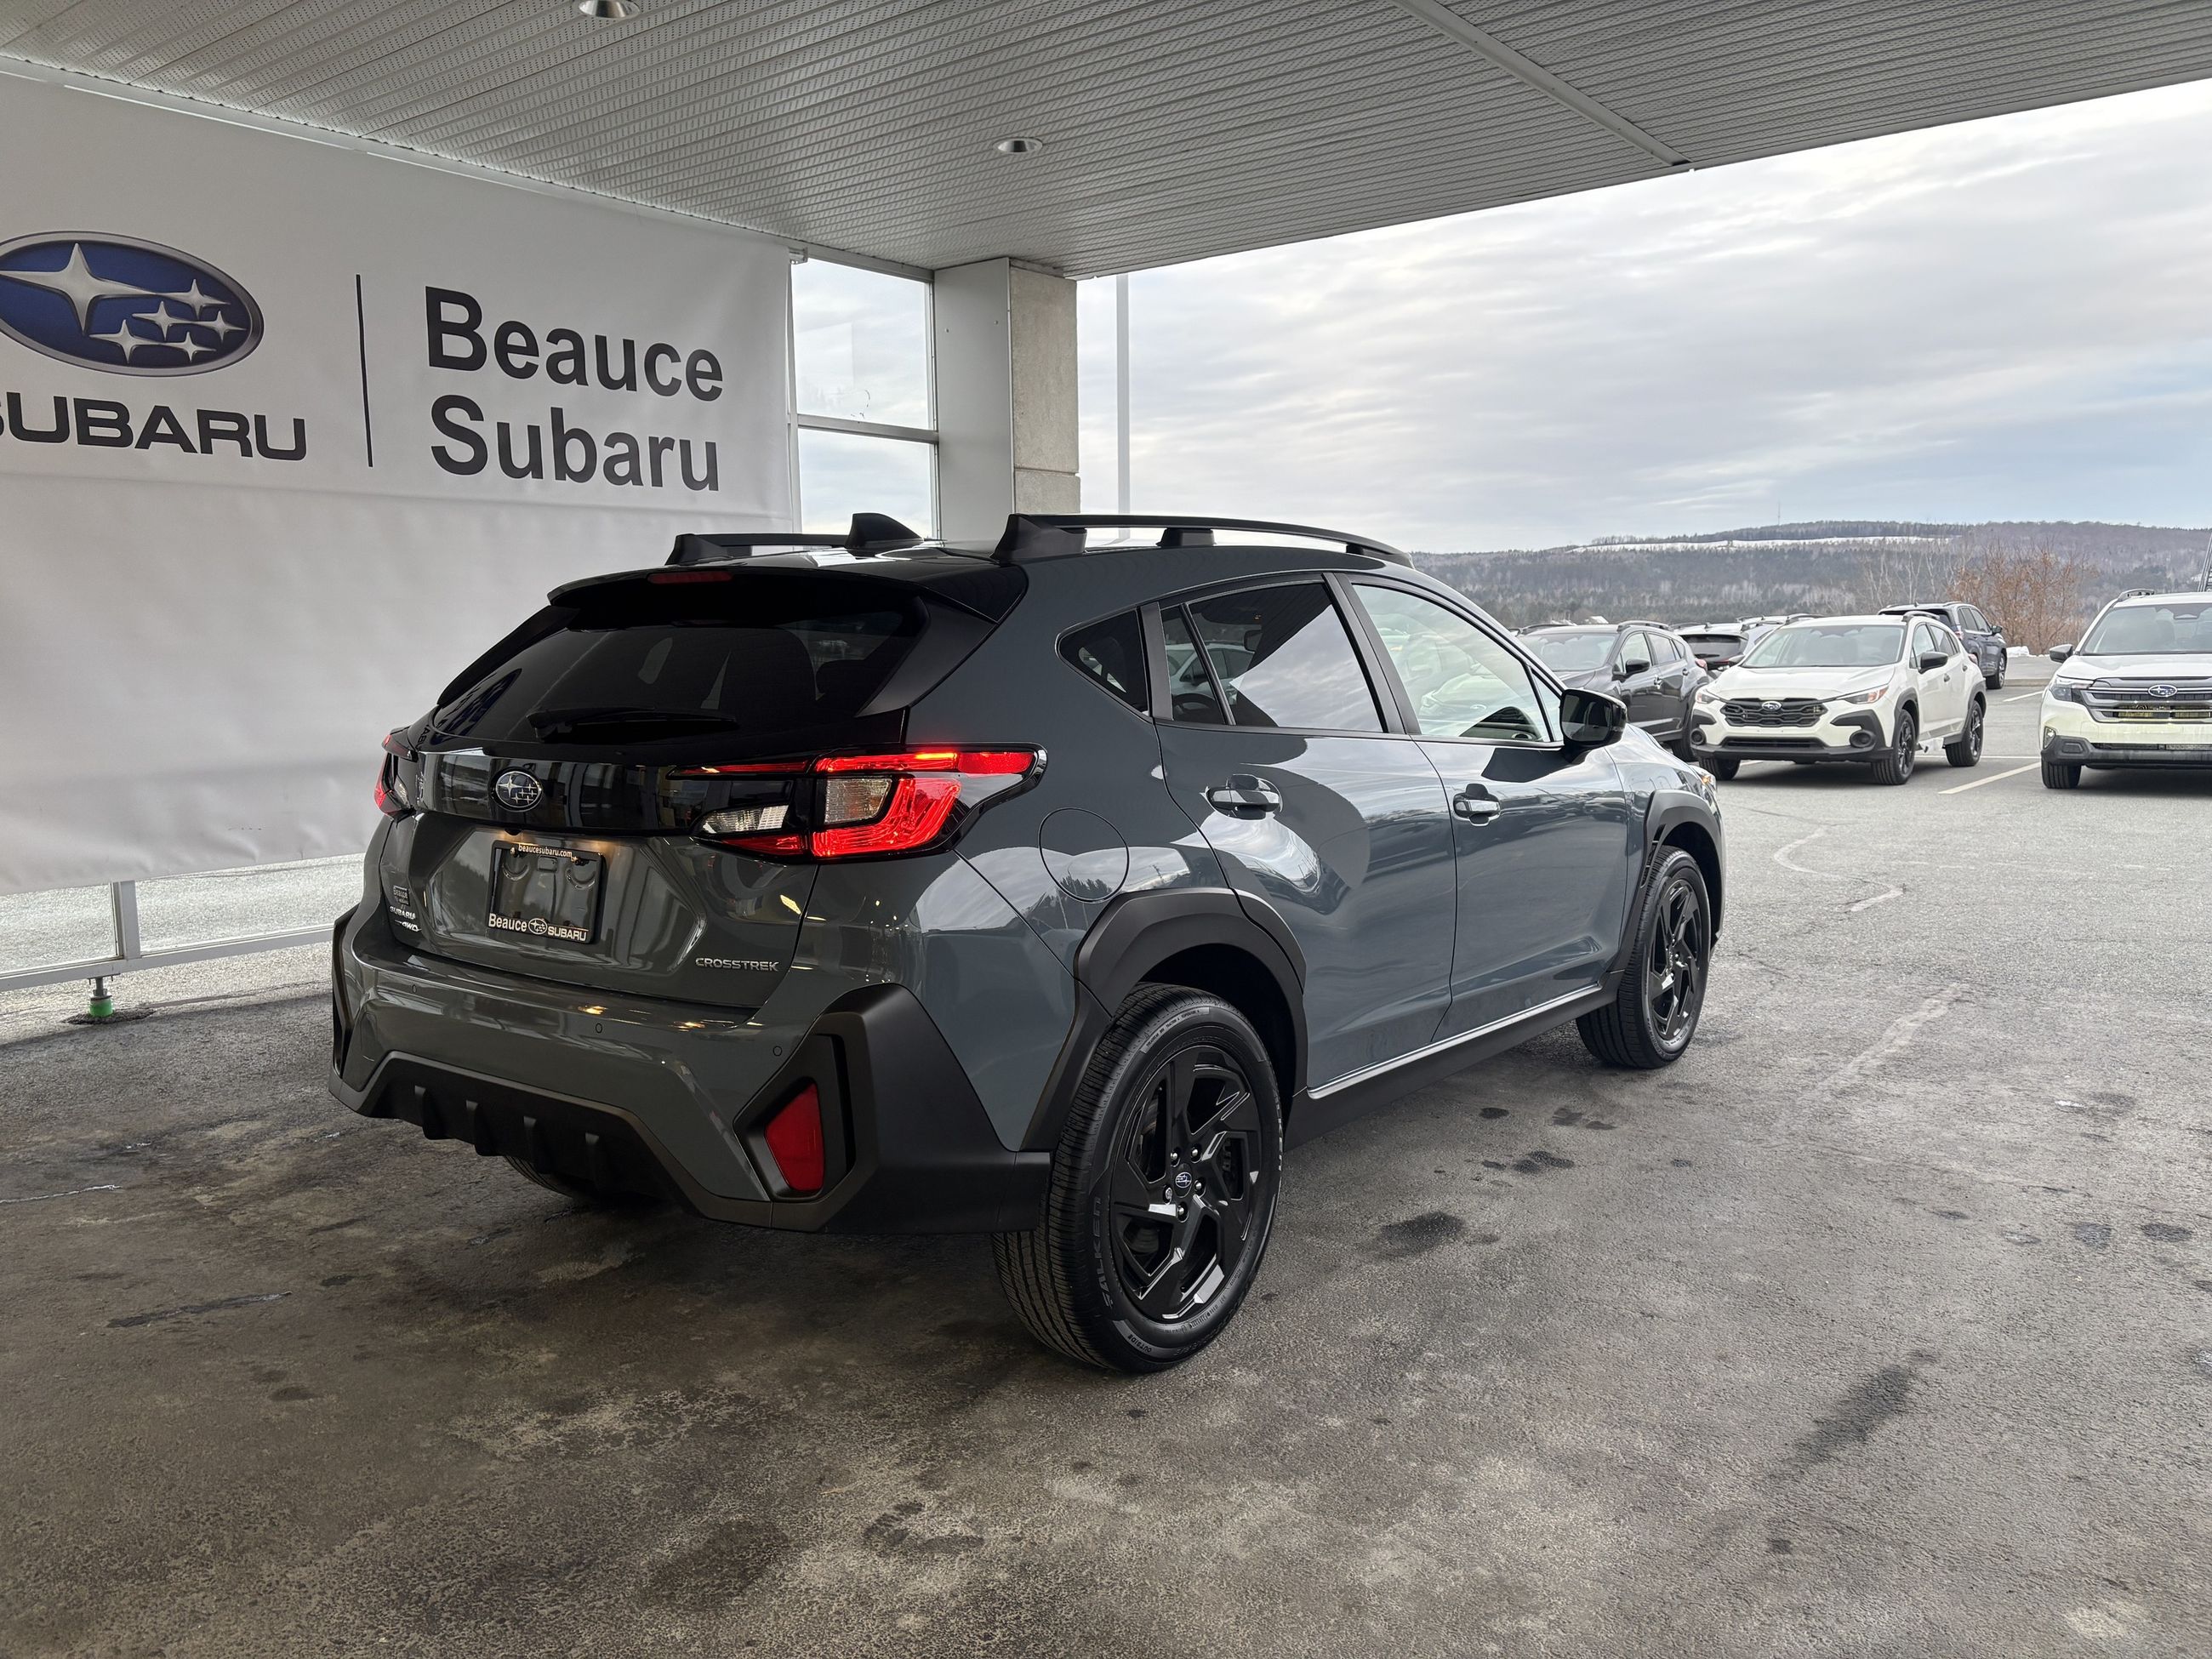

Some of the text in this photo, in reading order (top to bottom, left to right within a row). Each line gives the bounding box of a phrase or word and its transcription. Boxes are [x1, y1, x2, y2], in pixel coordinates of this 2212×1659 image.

[425, 286, 723, 402] Beauce
[430, 394, 719, 492] Subaru
[518, 844, 573, 858] beaucesubaru.com
[488, 913, 587, 941] Beauce SUBARU
[695, 957, 779, 972] CROSSTREK
